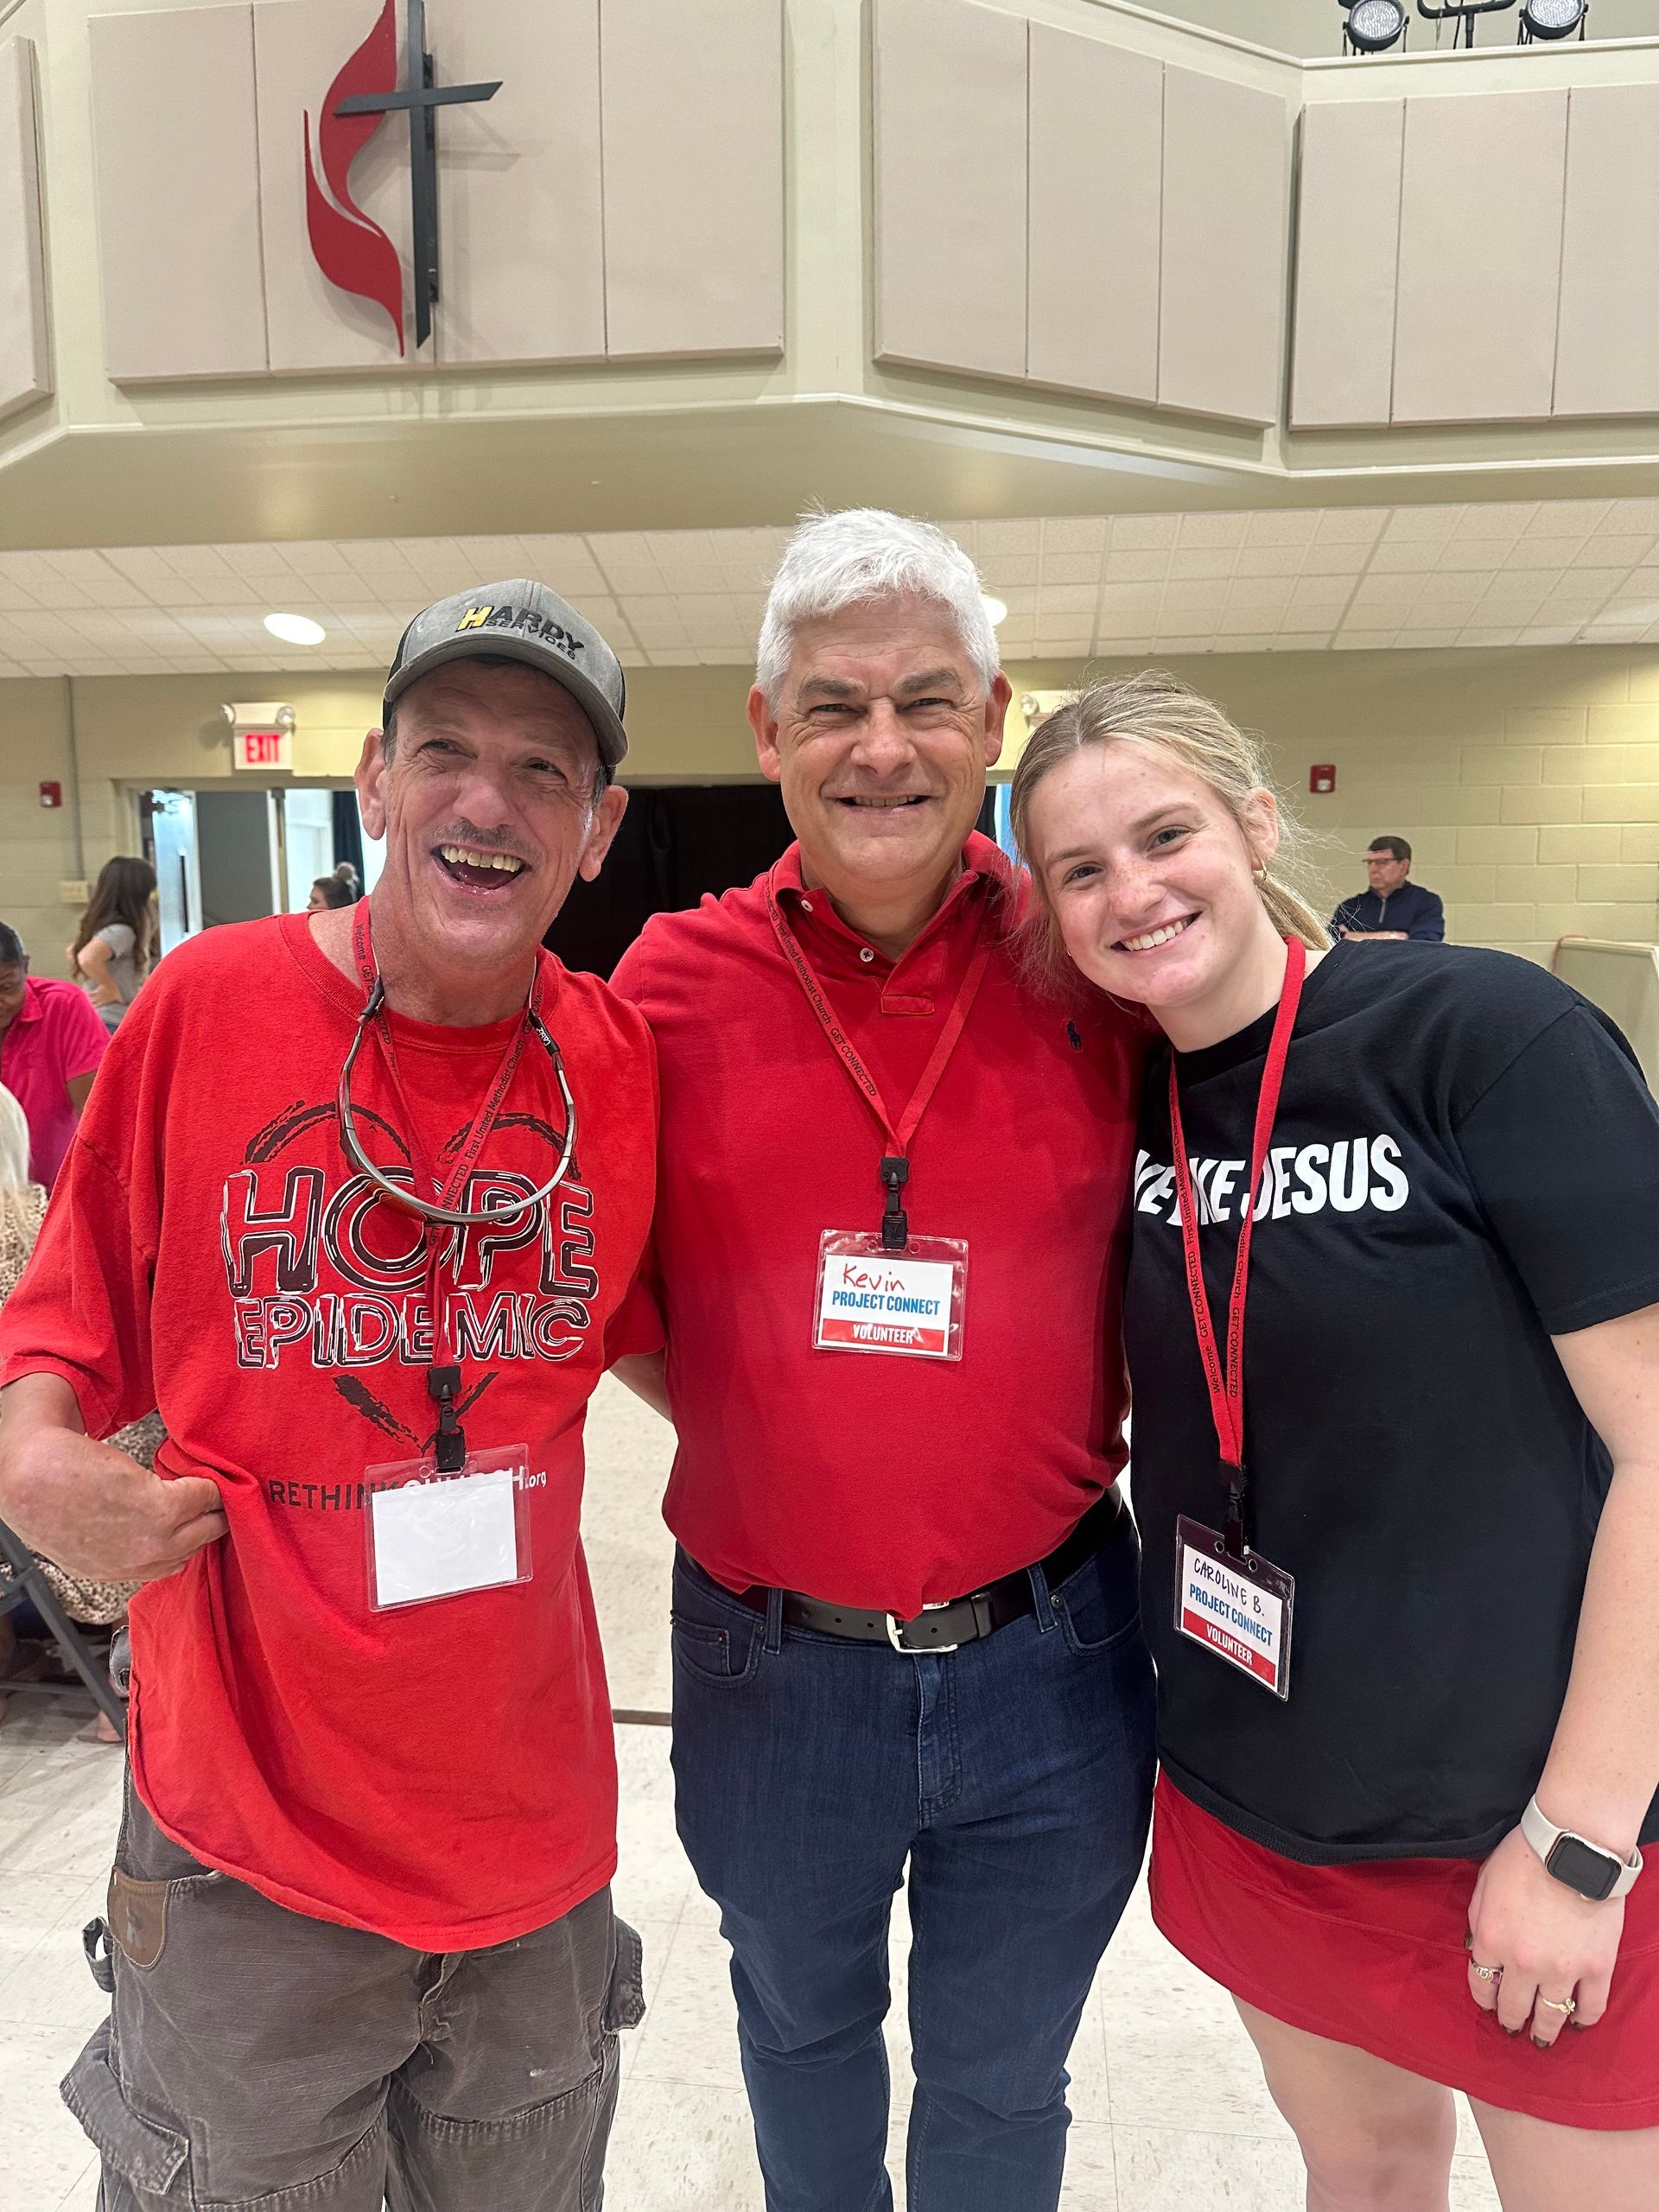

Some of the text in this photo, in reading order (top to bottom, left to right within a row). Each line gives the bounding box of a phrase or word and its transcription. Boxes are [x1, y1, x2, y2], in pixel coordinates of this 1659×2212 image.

[455, 606, 584, 652] HARDY
[486, 620, 575, 660] SERVICES
[245, 734, 280, 763] EXIT
[355, 923, 366, 961] Welcome
[794, 954, 817, 995] Methodist
[812, 994, 833, 1025] Church
[830, 1027, 847, 1046] GET
[841, 1043, 877, 1096] CONNECTED
[442, 1164, 469, 1211] NNECTED
[465, 1141, 480, 1160] First
[474, 1110, 493, 1141] United
[488, 1069, 512, 1111] Methodist
[507, 1039, 525, 1070] Church
[1173, 1147, 1188, 1191] Methodist
[1241, 1135, 1409, 1222] JESUS
[1179, 1192, 1192, 1223] United
[220, 1166, 599, 1298] HOPE
[1185, 1221, 1195, 1246] First
[842, 1263, 906, 1293] Kevin
[1187, 1250, 1205, 1315] CONNECTED
[1234, 1261, 1243, 1300] Church
[832, 1290, 940, 1315] PROJECT CONNECT
[234, 1293, 590, 1369] EPIDEMIC
[853, 1324, 914, 1344] VOLUNTEER
[1198, 1318, 1209, 1339] GET
[1205, 1346, 1221, 1395] Welcome
[1230, 1331, 1239, 1398] CONNECTED
[1194, 1558, 1266, 1617] CAROLINE B.
[1190, 1583, 1273, 1647] PROJECT CONNECT
[1206, 1624, 1253, 1666] VOLUNTEER
